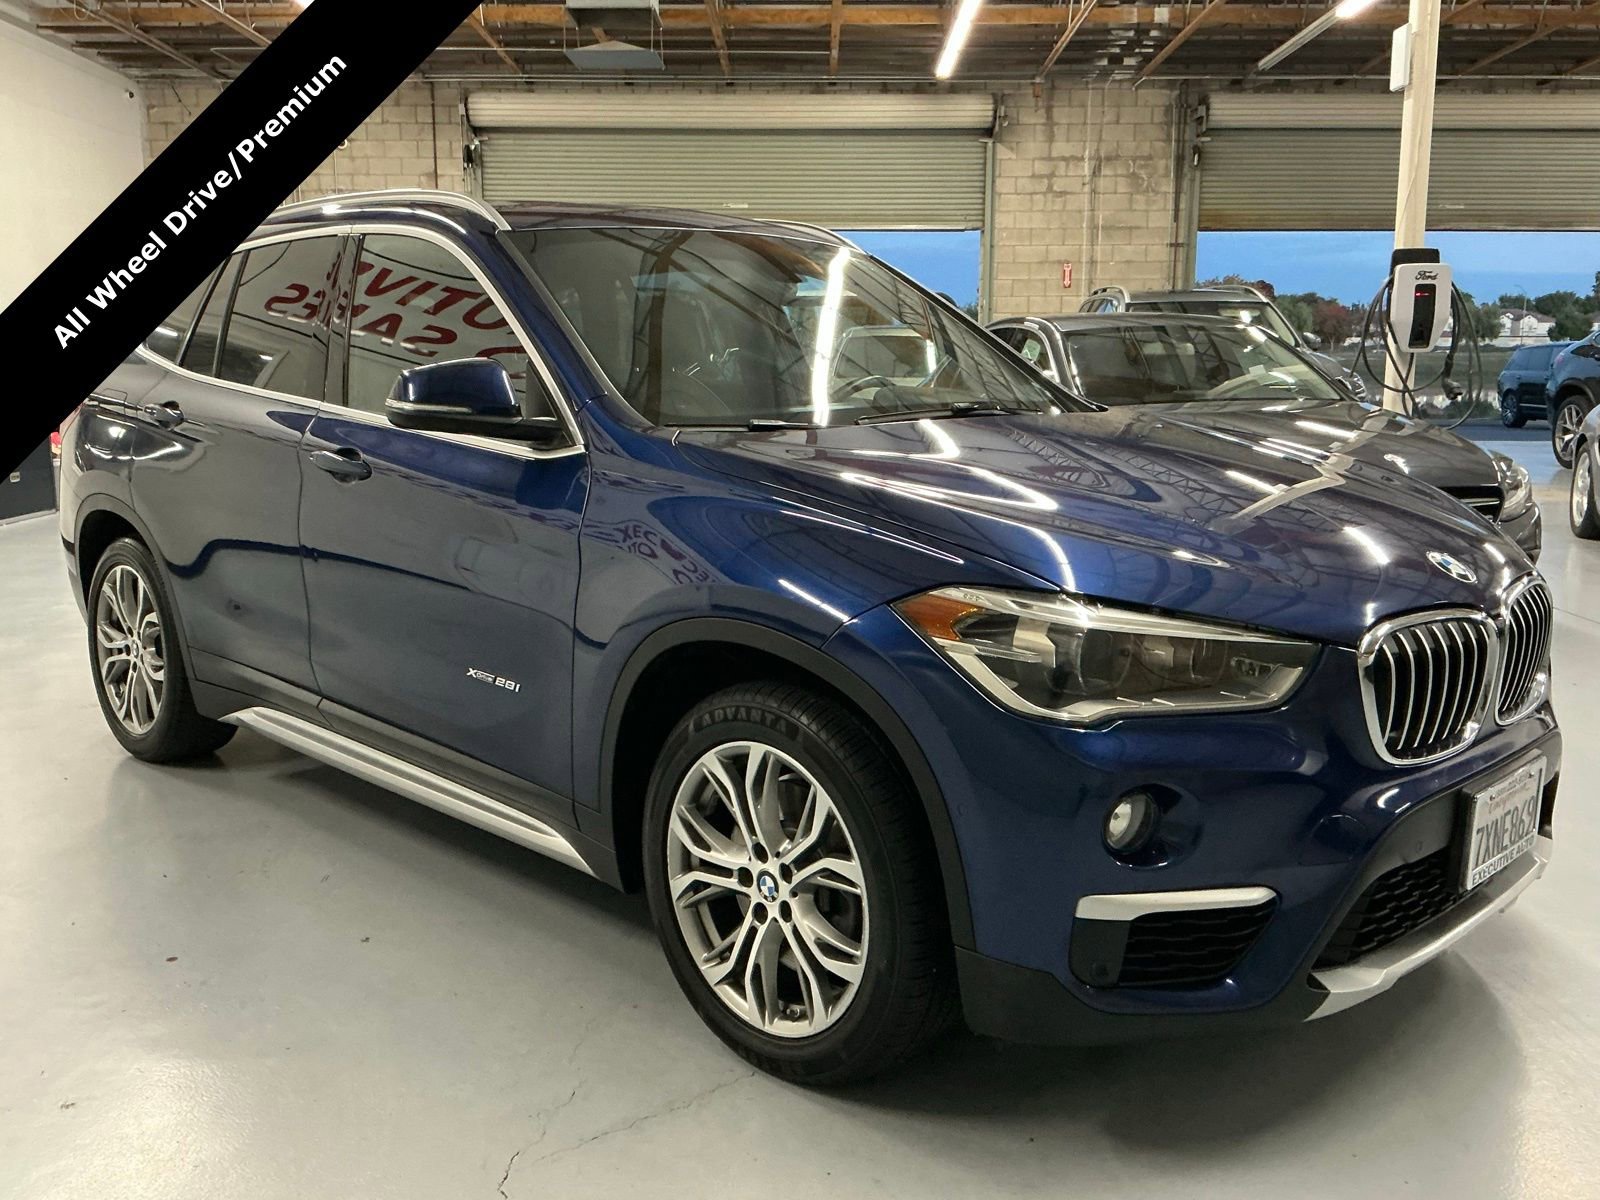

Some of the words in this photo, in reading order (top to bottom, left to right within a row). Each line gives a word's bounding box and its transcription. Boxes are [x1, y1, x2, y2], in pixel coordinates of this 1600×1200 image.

[1415, 270, 1439, 281] Ford
[702, 706, 788, 733] ADVANTA
[1475, 796, 1536, 869] 7XNE869
[1472, 849, 1516, 886] EXECUTIVE
